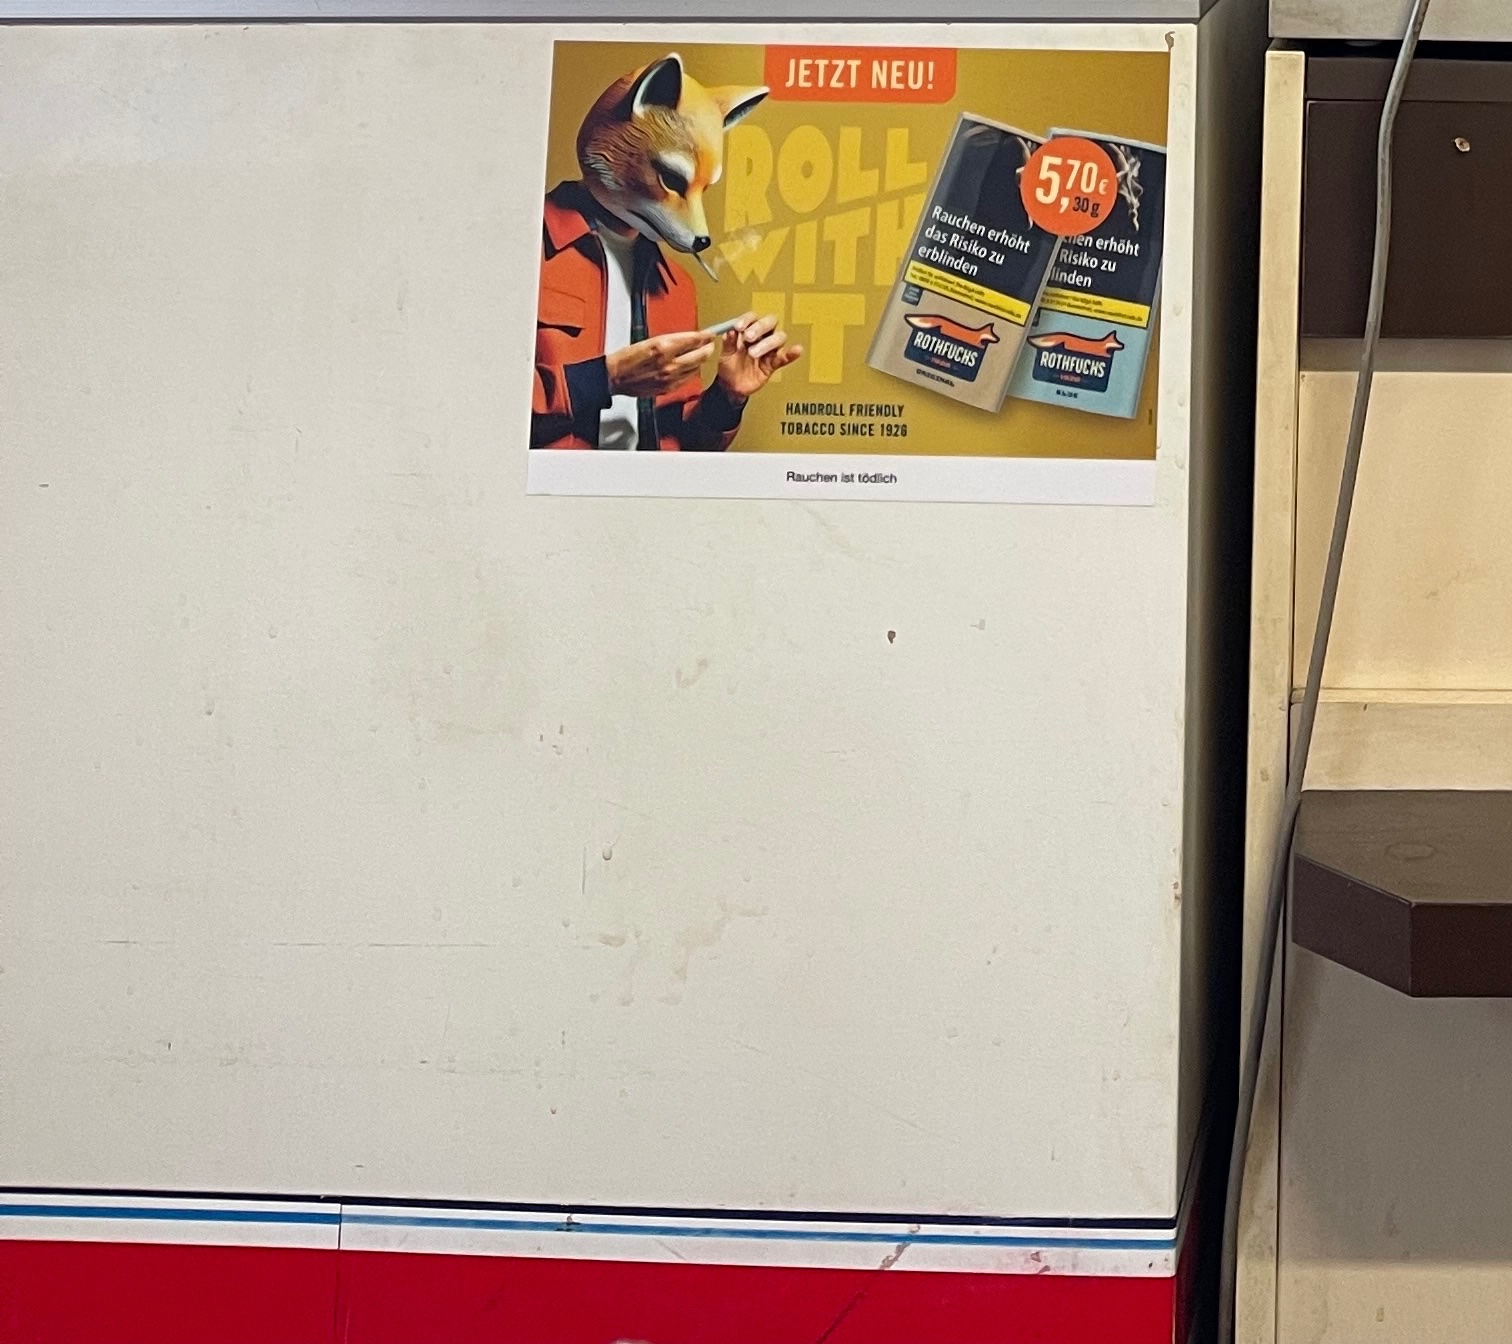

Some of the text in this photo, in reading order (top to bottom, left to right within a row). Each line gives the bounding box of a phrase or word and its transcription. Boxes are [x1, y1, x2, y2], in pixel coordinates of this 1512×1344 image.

[785, 59, 934, 90] JETZT NEU!
[724, 124, 928, 233] ROLL
[1072, 196, 1101, 218] 30 g
[718, 192, 927, 286] WITH
[931, 205, 1031, 254] Rauchen erhöht
[924, 225, 1005, 266] das Risiko zu
[1095, 237, 1140, 258] erhöht
[918, 245, 978, 277] erblinden
[1059, 249, 1116, 273] Risiko zu
[913, 331, 979, 368] ROTHFUCHS
[1039, 351, 1106, 378] ROTHFUCHS
[785, 402, 905, 417] HANDROLL FRIENDLY
[780, 421, 835, 436] TOBACCO
[839, 422, 875, 437] SINCE
[786, 471, 898, 484] Rauchen ist tödlich
